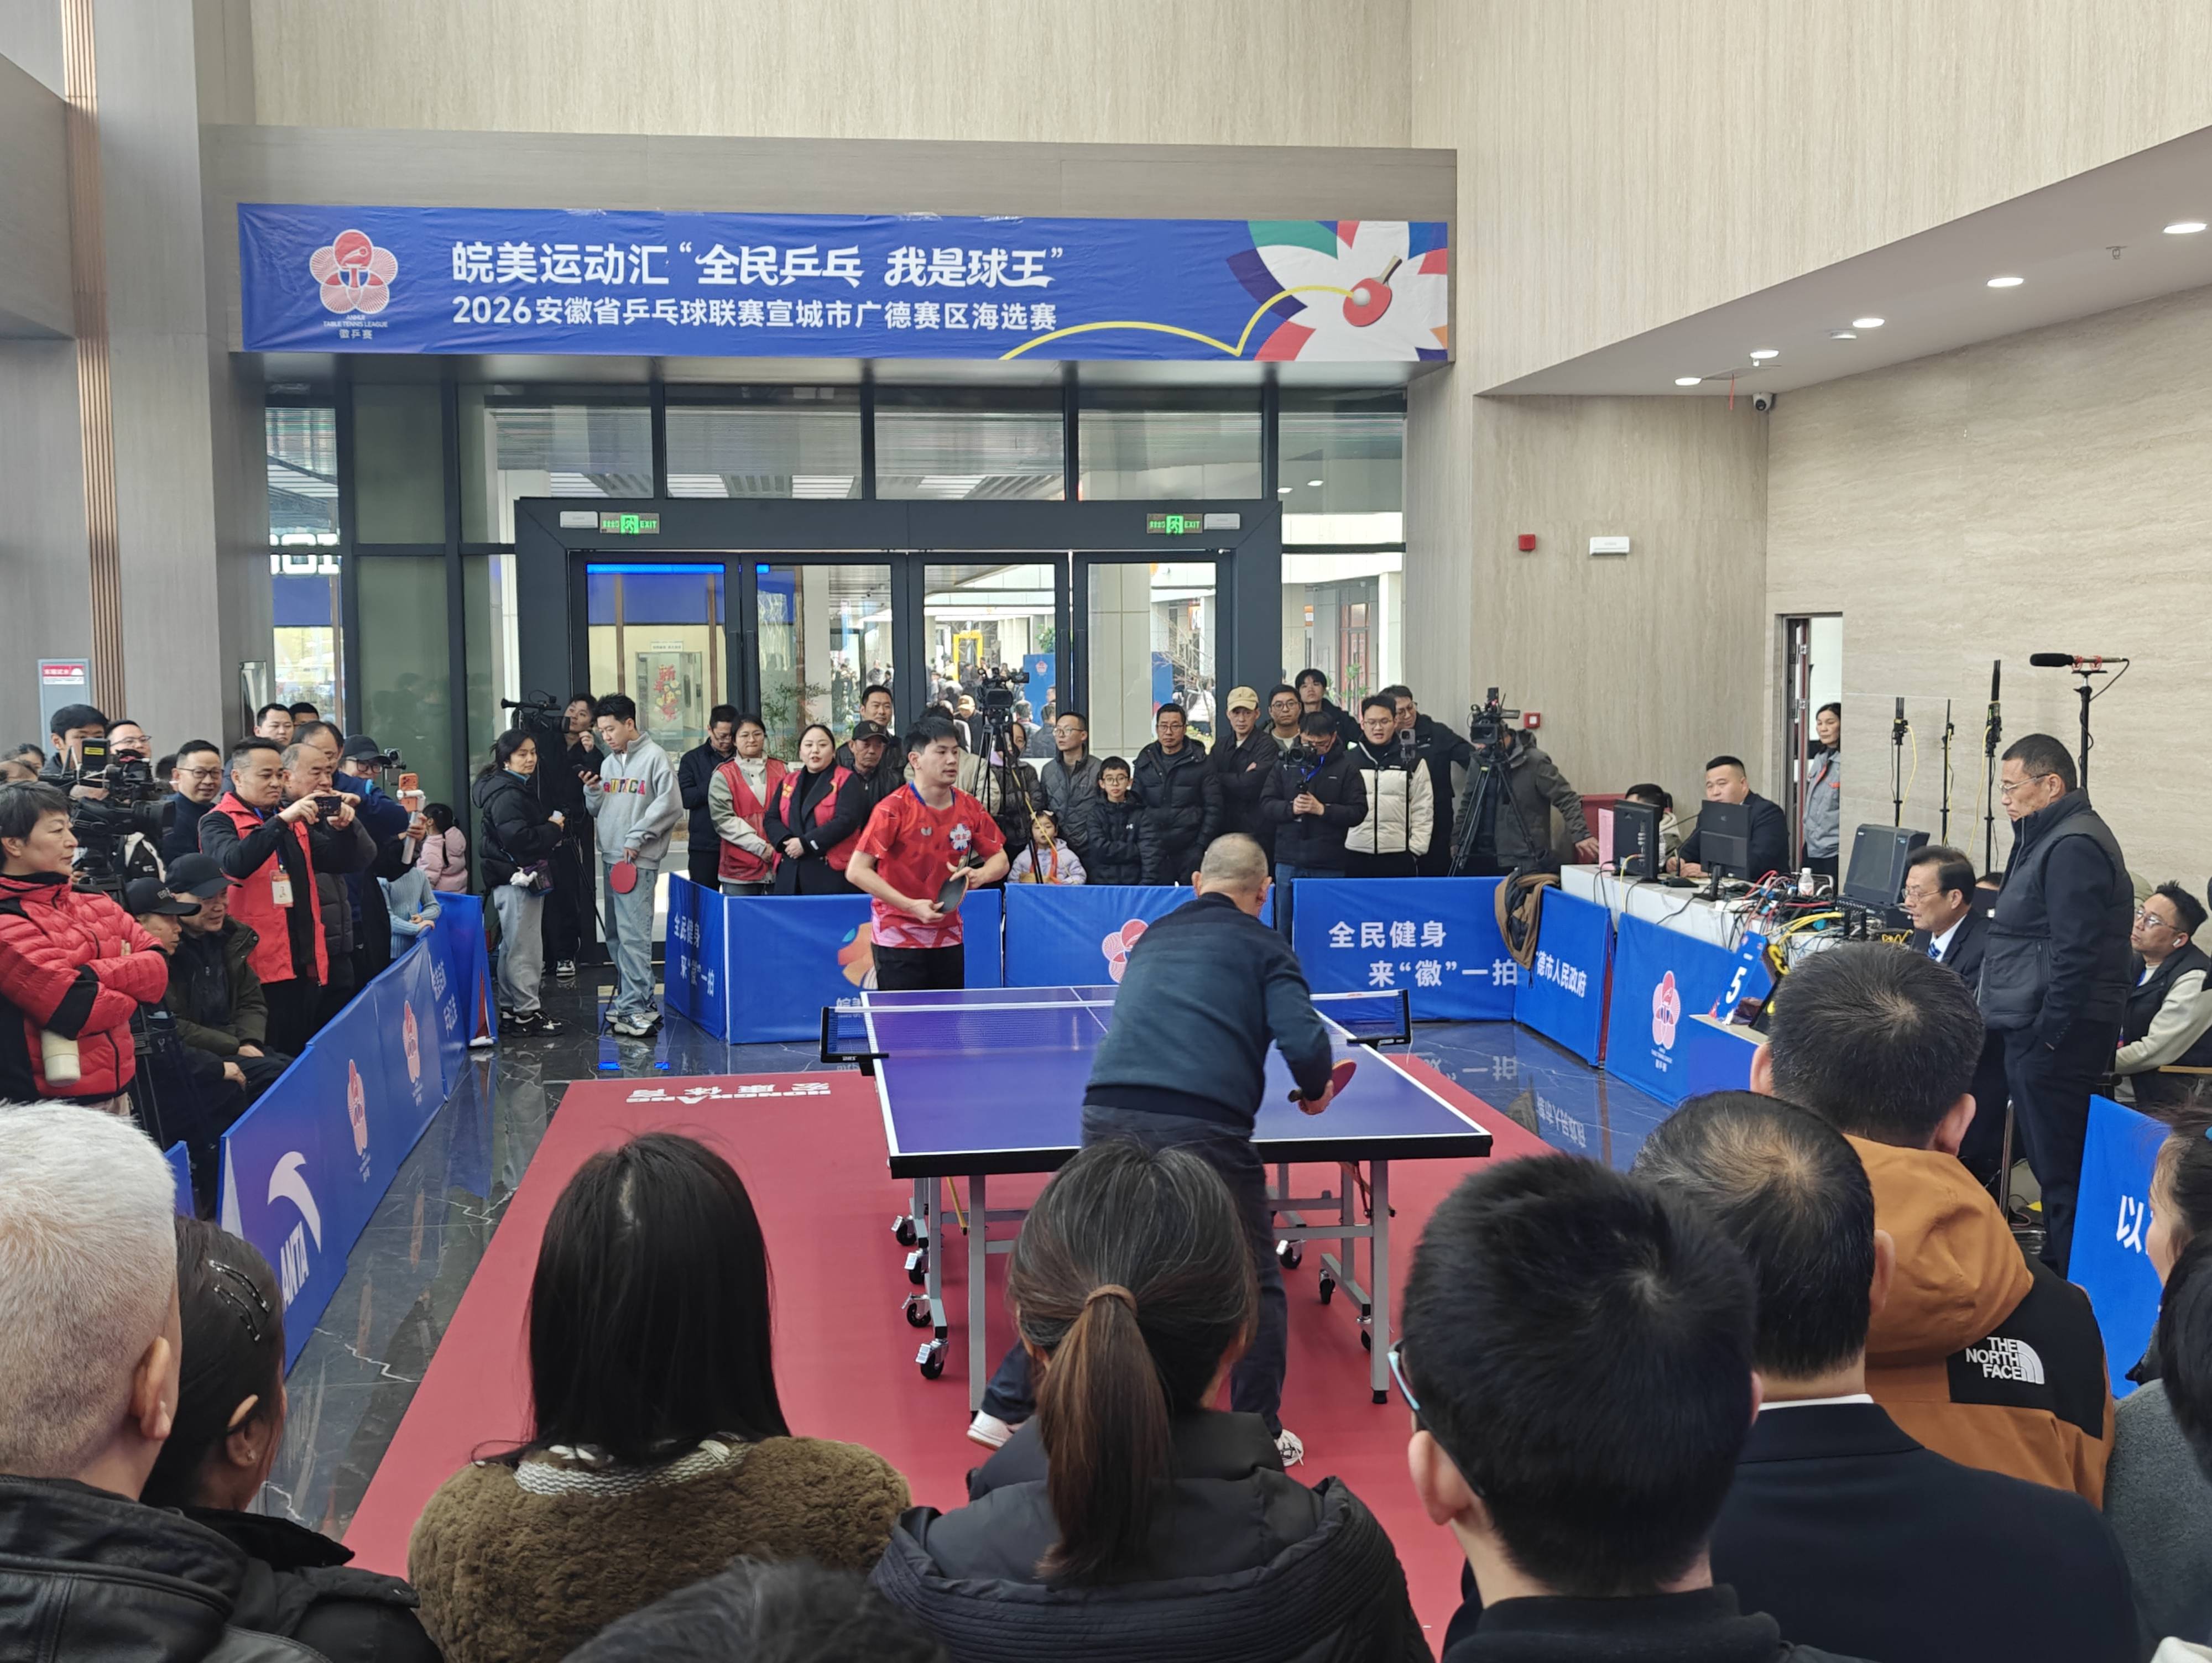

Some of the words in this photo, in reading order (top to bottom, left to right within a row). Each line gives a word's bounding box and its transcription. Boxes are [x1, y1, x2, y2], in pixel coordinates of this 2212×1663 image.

[452, 296, 1057, 332] 2026安徽省乒乓球联赛宣城市广德赛区海选赛
[640, 520, 657, 529] EXIT
[1328, 921, 1447, 948] 全民健身
[1536, 950, 1587, 998] 德市人民政府
[1725, 966, 1747, 1003] 5
[626, 1090, 831, 1104] HONGKANG
[2116, 1195, 2153, 1254] 以
[280, 1220, 309, 1314] ANTA
[1965, 1347, 2021, 1367] NORTH
[1986, 1336, 2018, 1353] THE
[1983, 1363, 2023, 1381] FACE
